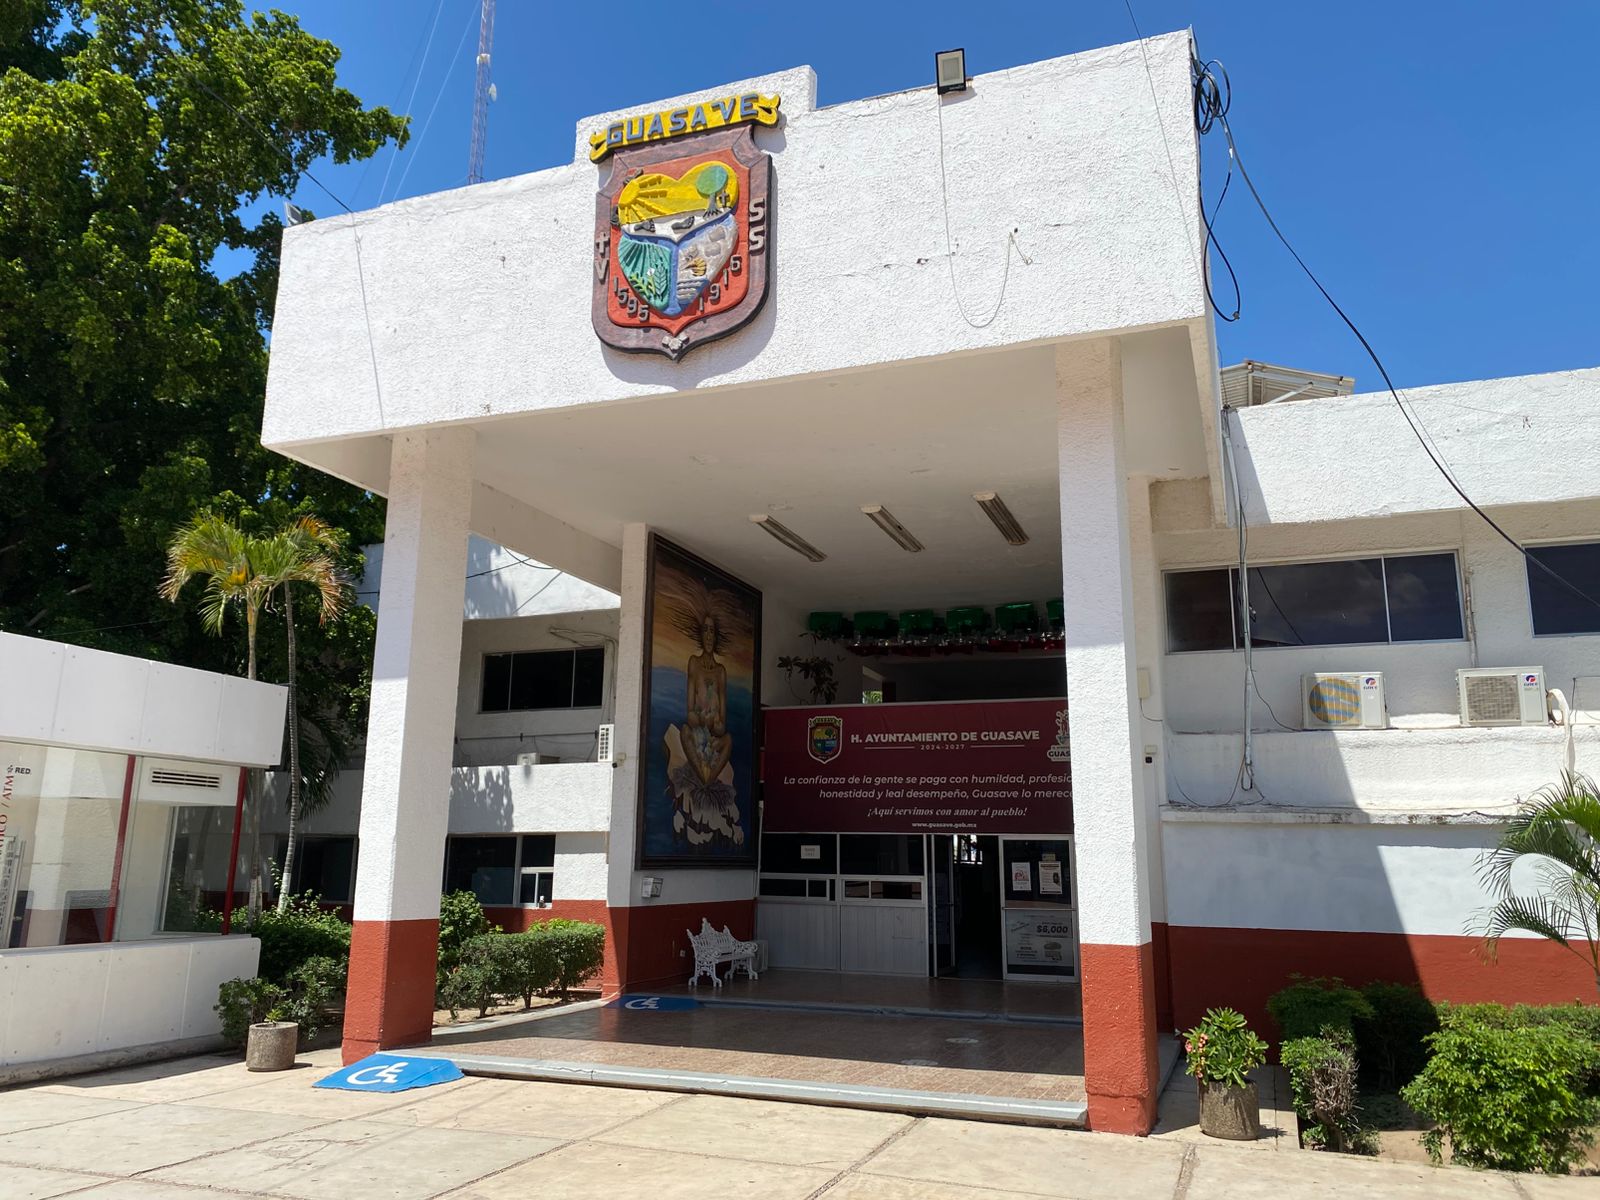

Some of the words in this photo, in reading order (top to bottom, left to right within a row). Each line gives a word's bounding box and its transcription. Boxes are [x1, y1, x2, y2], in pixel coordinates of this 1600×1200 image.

[606, 94, 759, 145] GUASAVE
[698, 255, 741, 311] 1916
[613, 276, 649, 321] 1595
[851, 734, 862, 743] H.
[865, 732, 958, 743] AYUNTAMIENTO
[961, 732, 977, 741] DE
[981, 730, 1040, 741] GUASAVE
[15, 767, 31, 775] RED
[783, 776, 795, 785] La
[797, 775, 846, 785] confianza
[847, 775, 860, 784] de
[862, 775, 872, 784] la
[874, 776, 905, 786] gente
[918, 776, 946, 786] paga
[971, 774, 1026, 785] humildad,
[819, 788, 875, 799] honestidad
[876, 791, 884, 800] y
[885, 789, 904, 799] leal
[906, 787, 969, 800] desempeño,
[972, 788, 1019, 798] Guasave
[1021, 788, 1031, 798] lo
[894, 807, 934, 816] servimos
[935, 808, 951, 816] con
[954, 808, 979, 816] amor
[980, 807, 990, 816] al
[990, 807, 1028, 818] pueblo!
